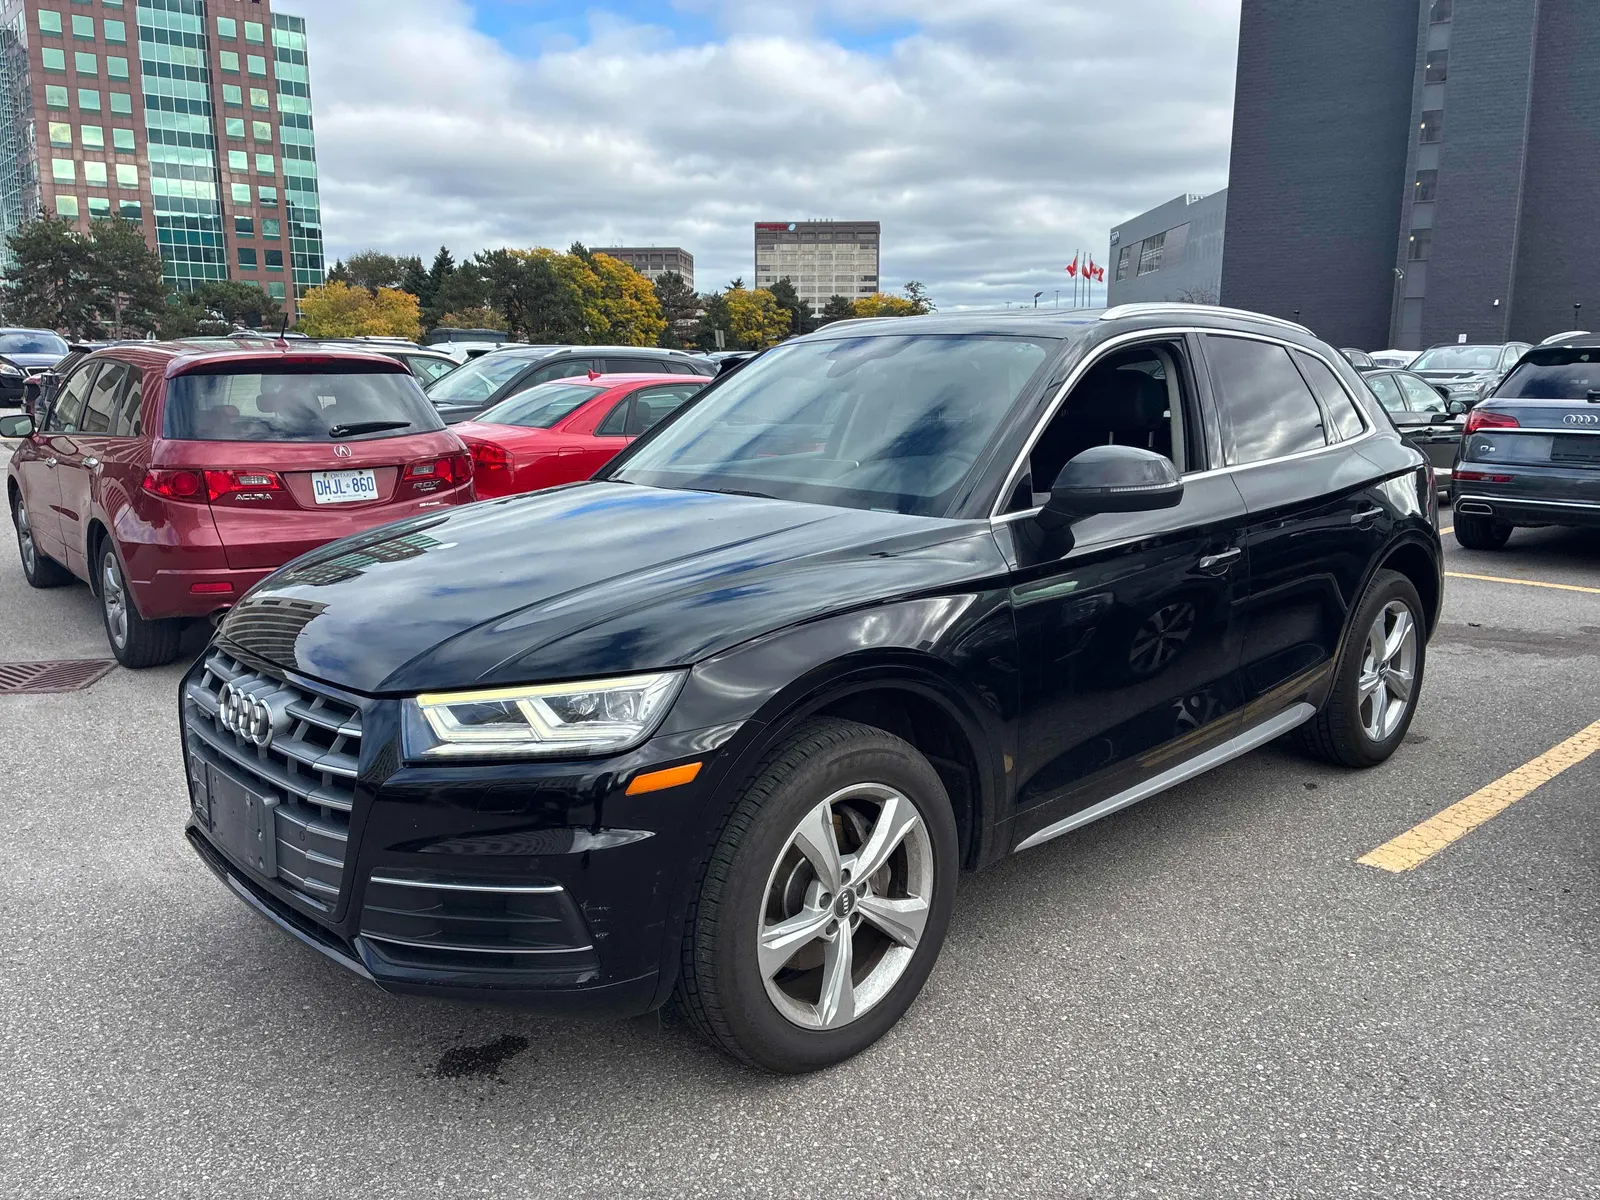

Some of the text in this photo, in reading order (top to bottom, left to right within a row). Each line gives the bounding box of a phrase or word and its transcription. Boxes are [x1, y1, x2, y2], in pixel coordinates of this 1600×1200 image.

[315, 476, 375, 496] DHJL 860
[235, 493, 273, 501] ACURA
